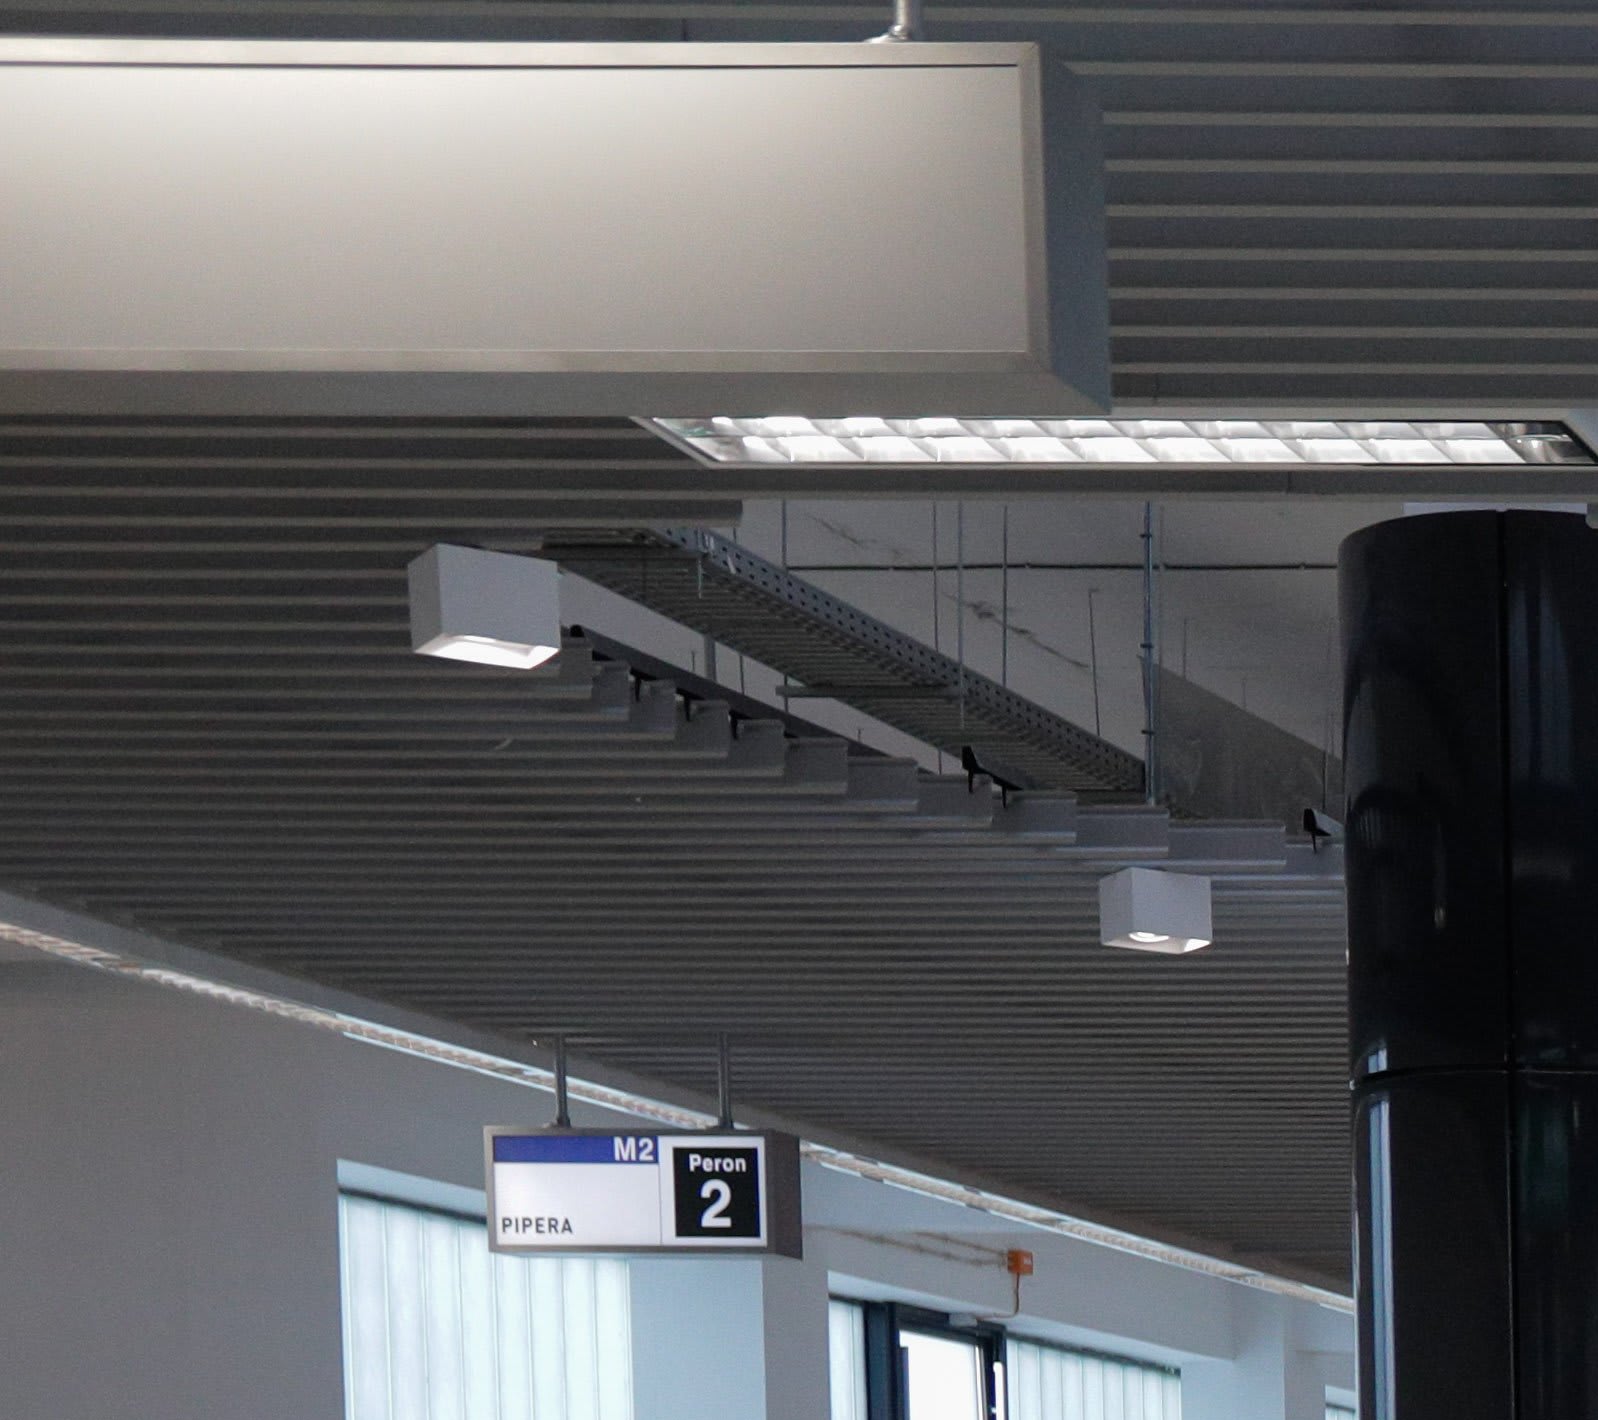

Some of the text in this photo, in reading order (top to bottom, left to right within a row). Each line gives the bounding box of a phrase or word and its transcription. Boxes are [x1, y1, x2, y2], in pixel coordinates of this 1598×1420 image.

[613, 1136, 655, 1162] M2
[689, 1153, 747, 1173] Peron
[700, 1178, 732, 1228] 2
[501, 1217, 573, 1234] PIPERA
